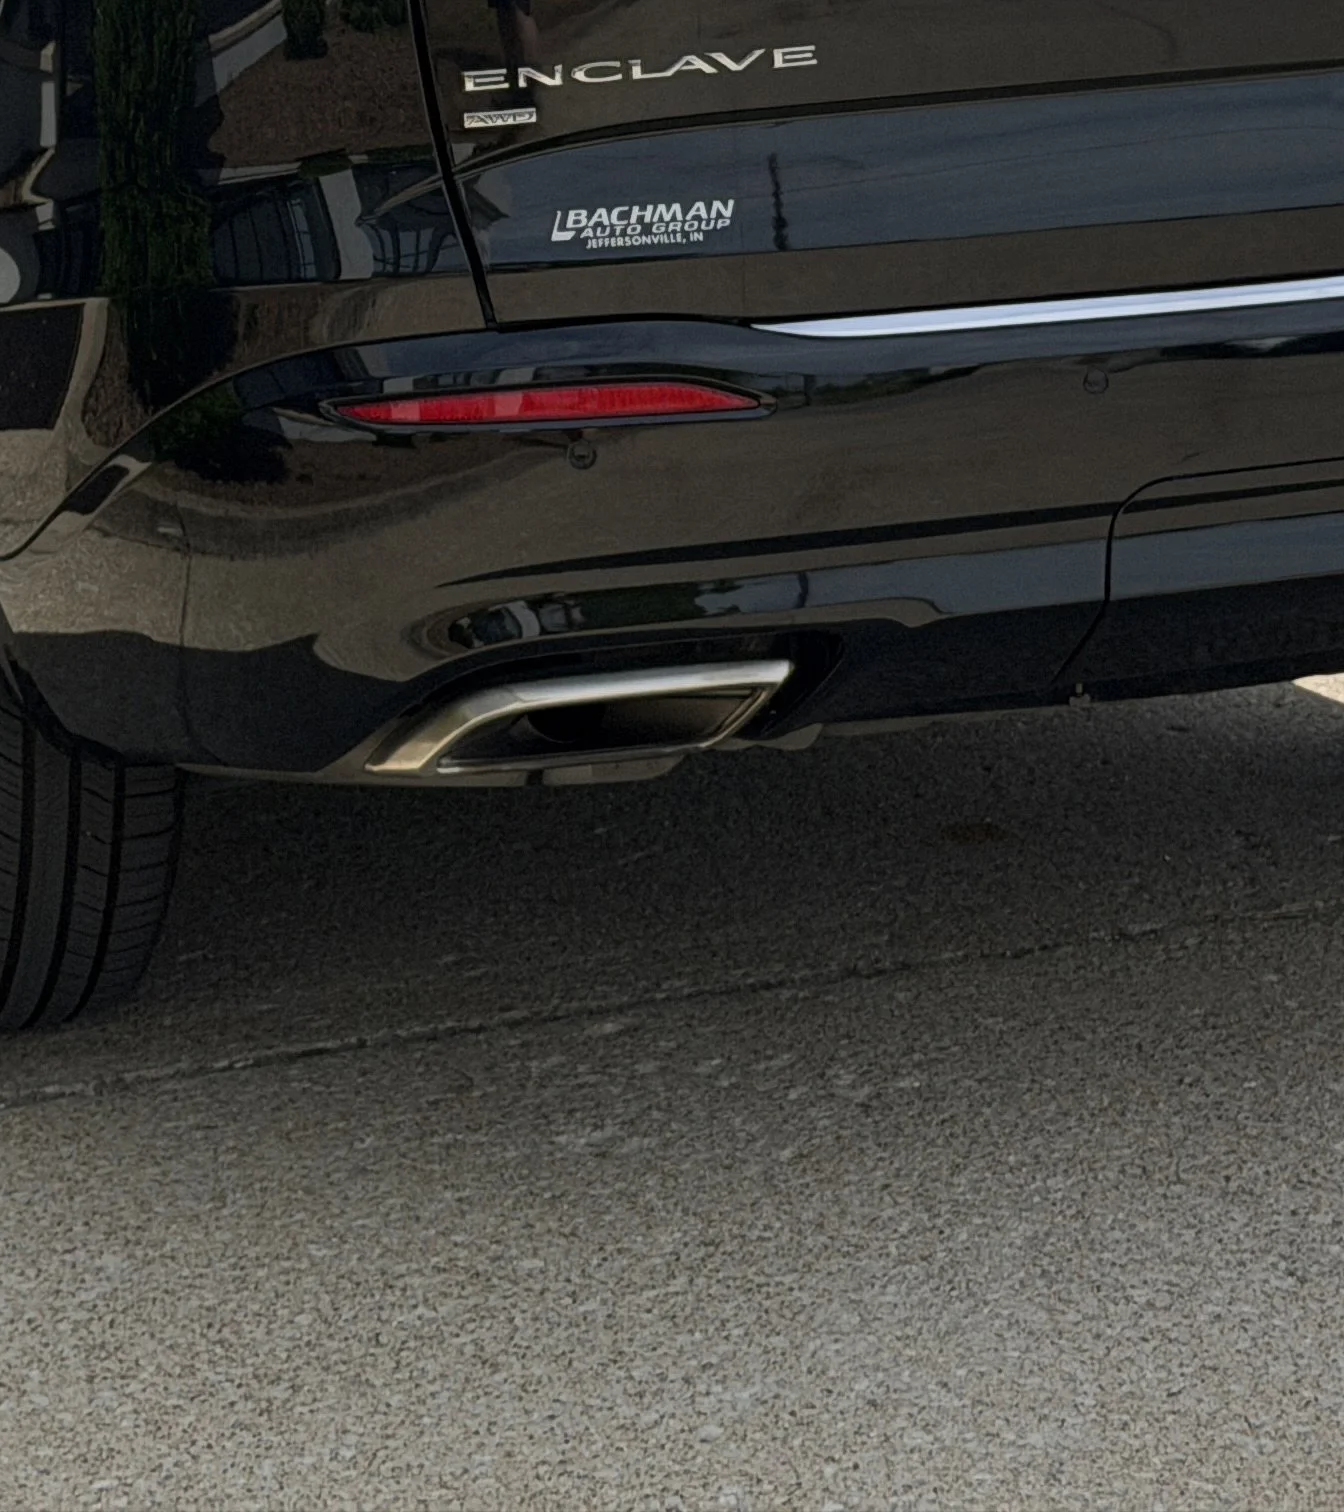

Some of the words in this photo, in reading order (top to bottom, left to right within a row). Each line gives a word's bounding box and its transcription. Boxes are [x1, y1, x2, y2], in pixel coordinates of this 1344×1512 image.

[462, 45, 818, 92] ENCLAVE
[465, 110, 535, 127] AWD
[565, 199, 735, 229] BACHMAN
[580, 225, 642, 238] AUTO
[651, 218, 732, 234] GROUP
[585, 233, 687, 250] JEFFERSONVILLE,
[689, 231, 705, 242] IN
